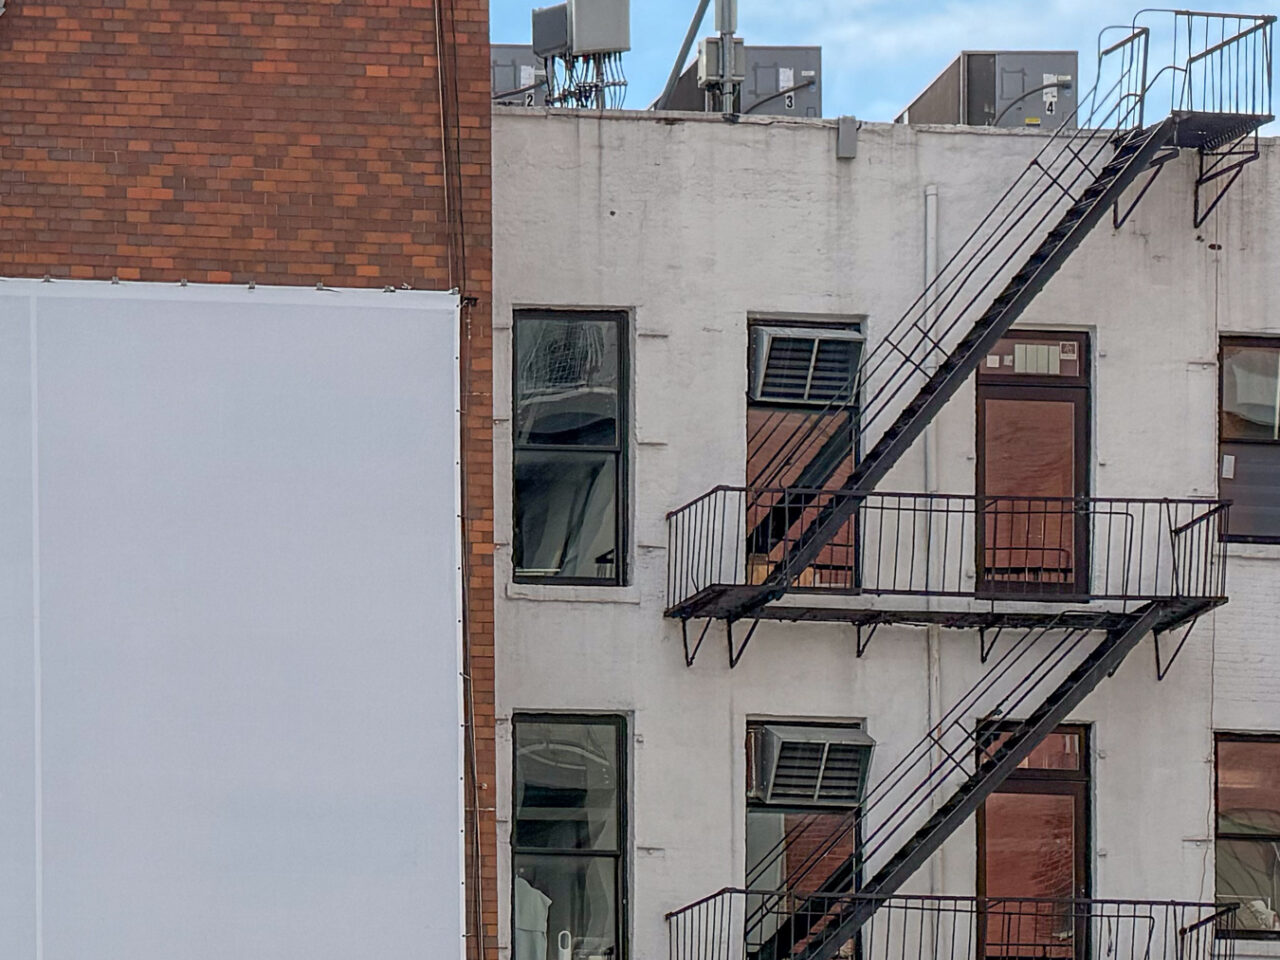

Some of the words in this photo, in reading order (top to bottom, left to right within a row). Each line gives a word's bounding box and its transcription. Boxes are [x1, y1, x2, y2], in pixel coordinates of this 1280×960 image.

[526, 94, 534, 107] 2
[786, 95, 793, 109] 3
[1046, 100, 1054, 114] 4
